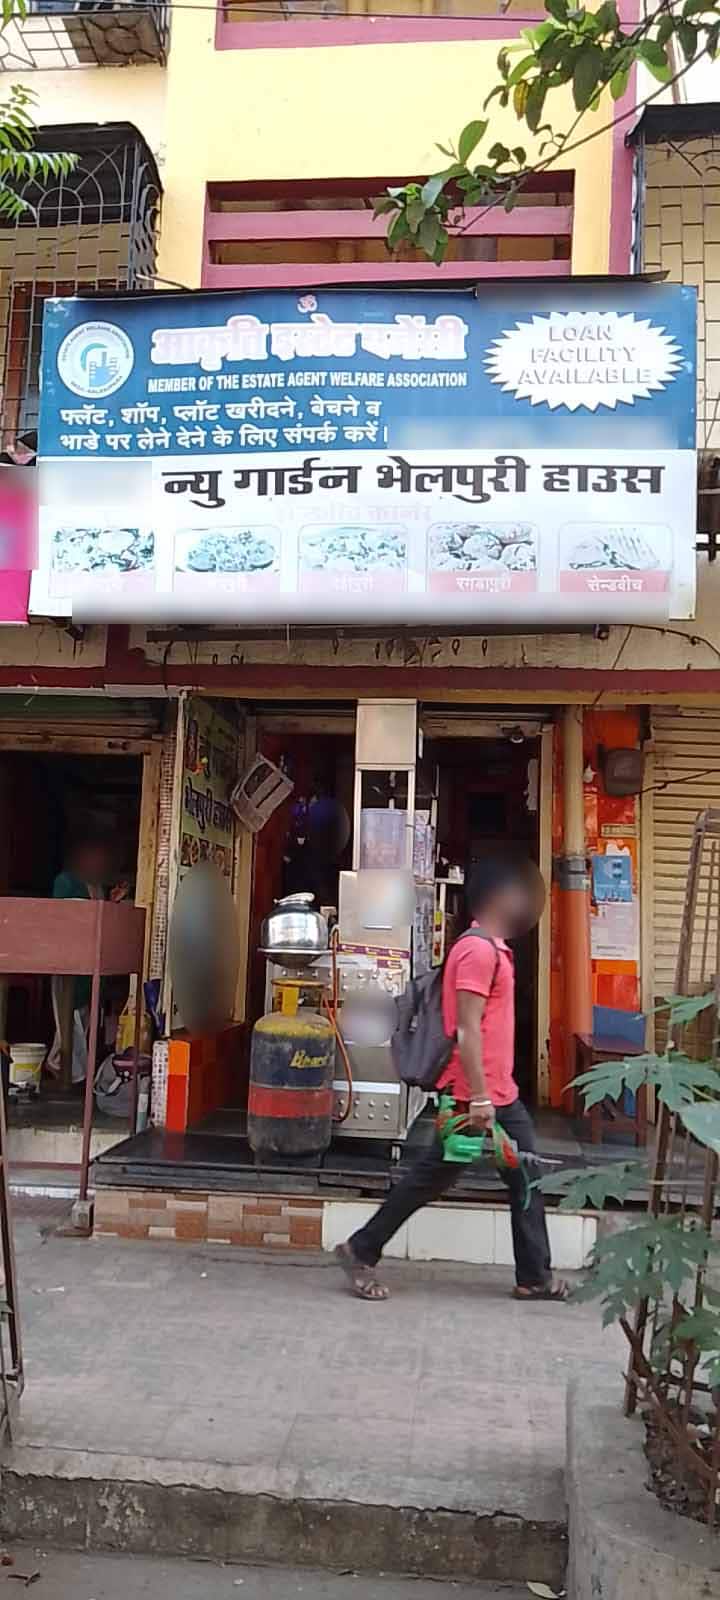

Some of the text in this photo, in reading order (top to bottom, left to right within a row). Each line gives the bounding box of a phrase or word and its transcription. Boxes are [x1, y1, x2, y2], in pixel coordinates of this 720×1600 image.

[549, 324, 613, 342] LOAN
[530, 347, 637, 363] FACILITY
[148, 372, 467, 393] MEMBER OF THE ESTATE AGENT WELFARE ASSOCIATION
[518, 367, 652, 384] AVAILABLE
[121, 401, 167, 425] शॉप,
[173, 400, 219, 422] प्लॉट
[225, 395, 302, 420] खरीदने,
[309, 394, 360, 417] बेचने
[365, 400, 382, 417] व
[60, 429, 100, 450] भाडे
[106, 433, 132, 450] पर
[137, 426, 170, 449] लेने
[177, 425, 209, 448] देने
[212, 424, 233, 446] के
[239, 423, 278, 448] लिए
[283, 421, 337, 444] संपर्क
[161, 456, 665, 509] न्यु गार्डन भेलपुरी हाउस
